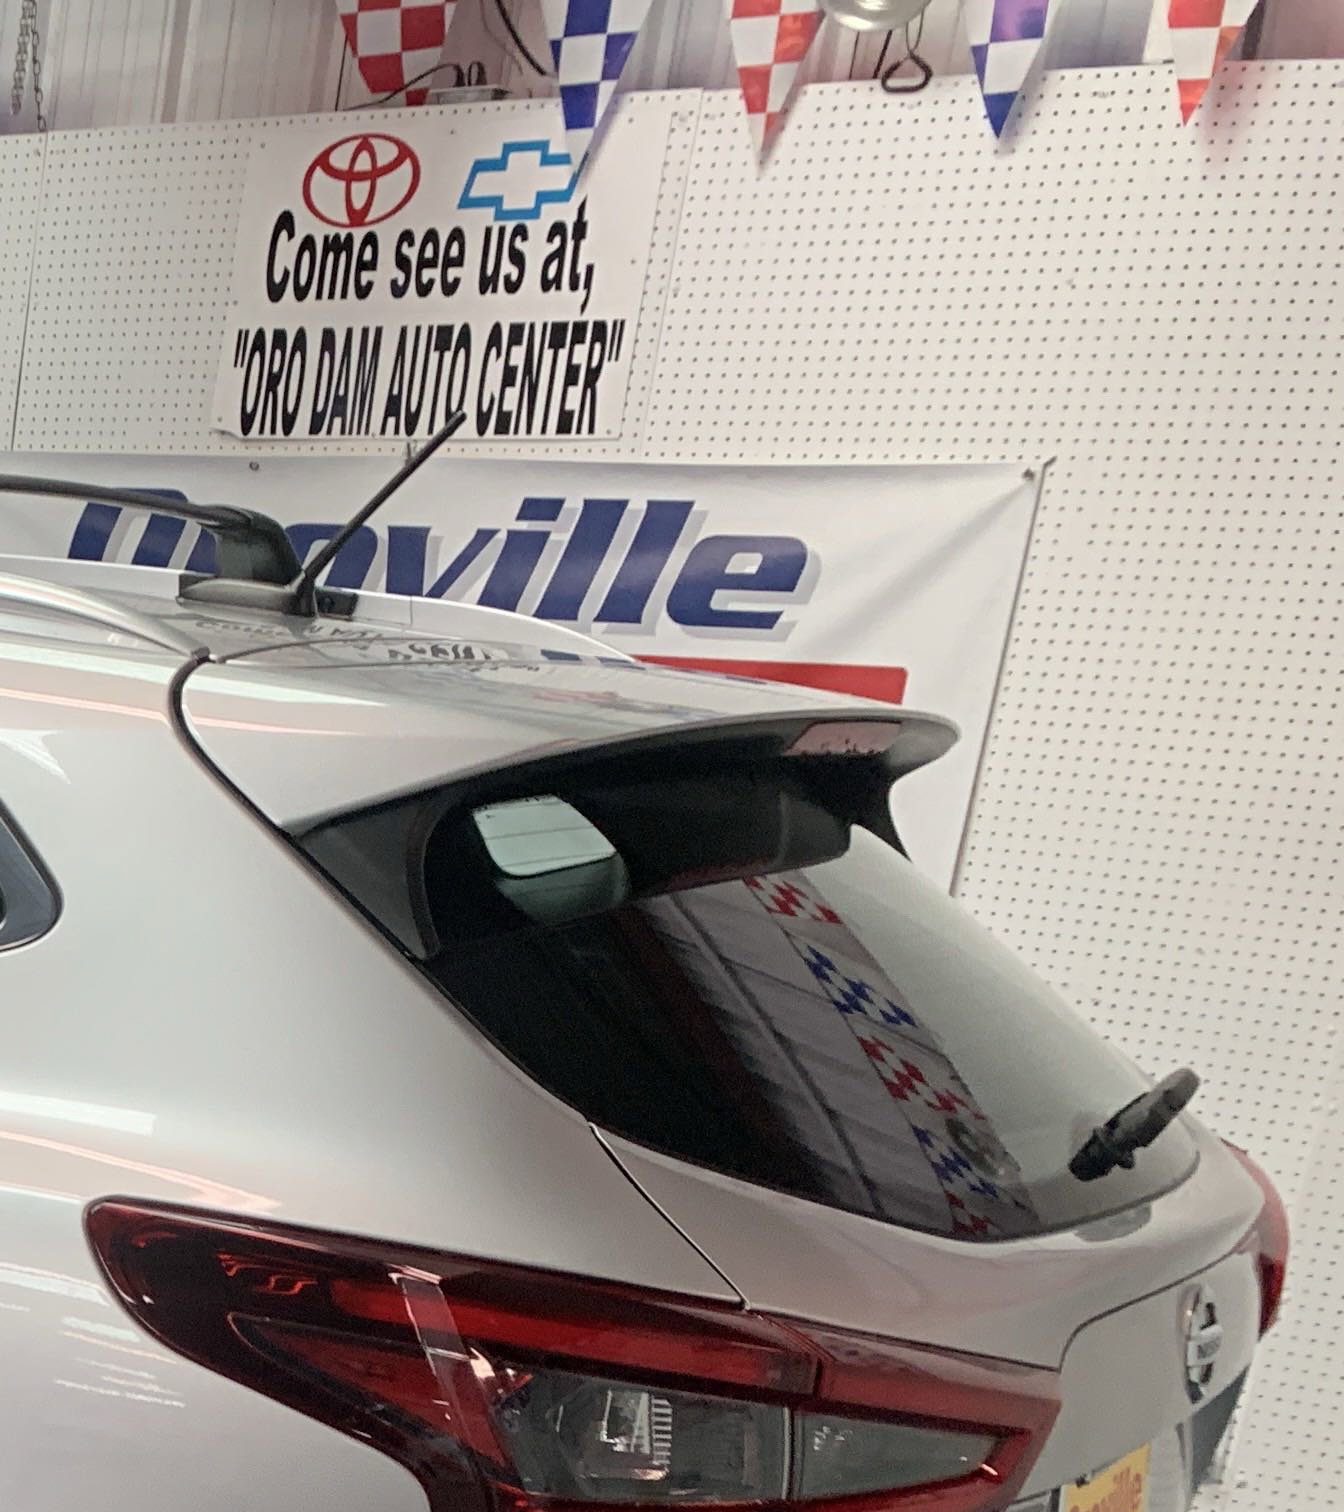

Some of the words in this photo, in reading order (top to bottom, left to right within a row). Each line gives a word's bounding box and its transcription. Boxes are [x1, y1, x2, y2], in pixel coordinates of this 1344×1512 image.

[265, 210, 378, 303] Come
[390, 226, 466, 297] see
[477, 220, 527, 295] us
[540, 194, 595, 317] at,
[233, 327, 307, 437] "ORO
[308, 324, 383, 436] DAM
[380, 322, 472, 437] AUTO
[475, 318, 627, 437] CENTER"
